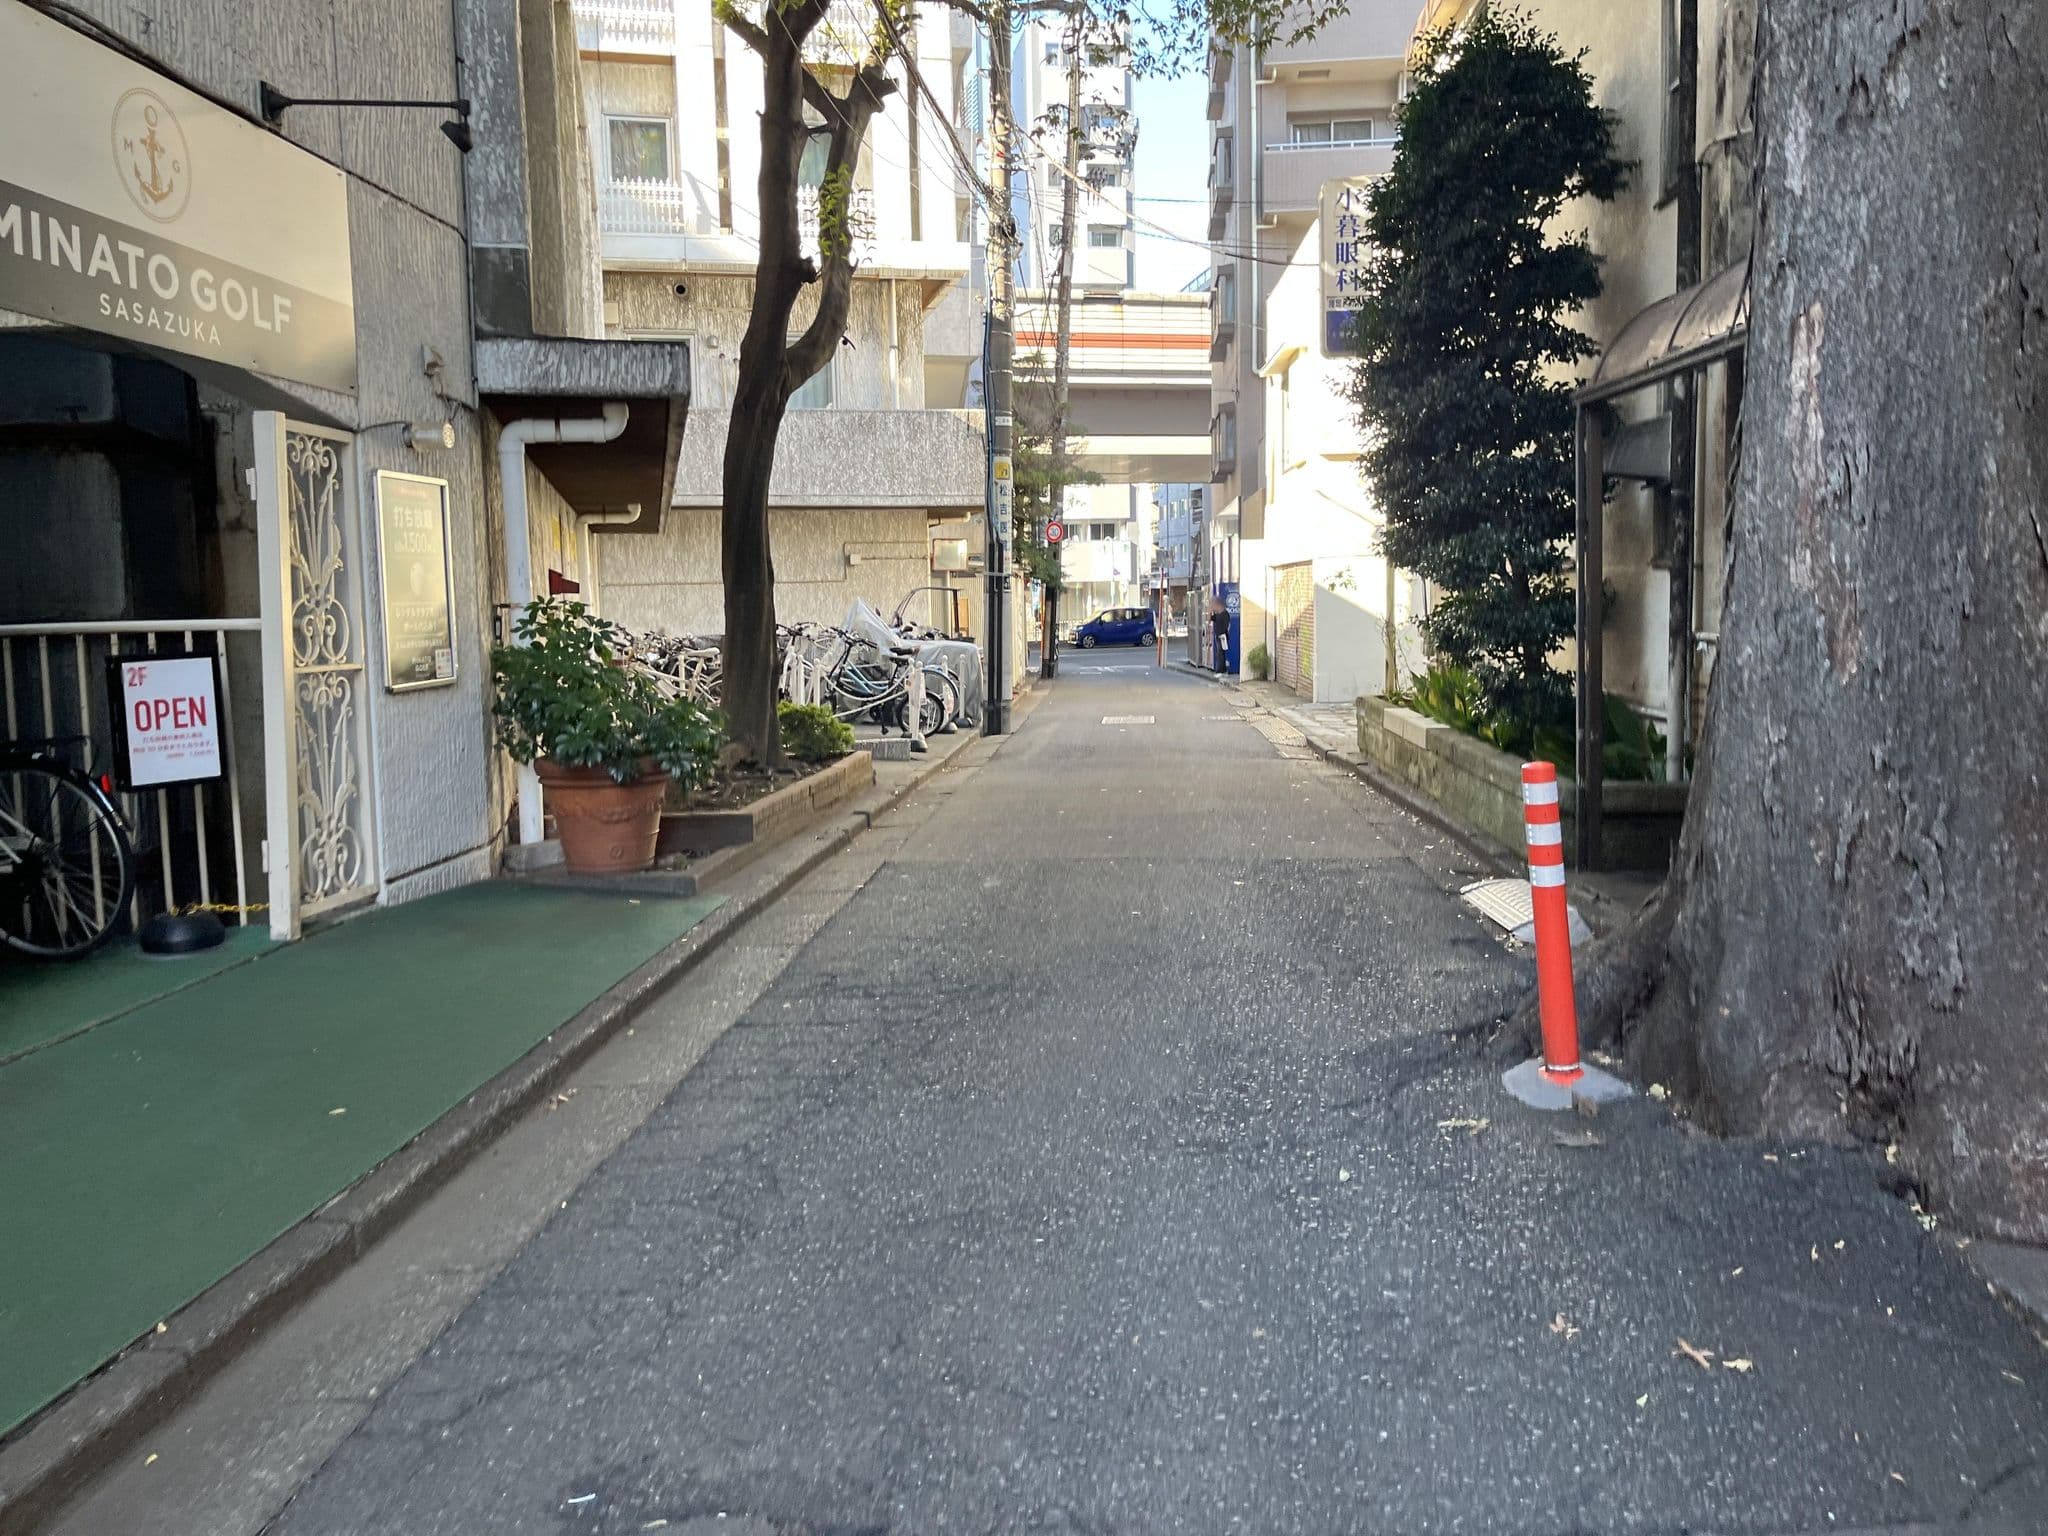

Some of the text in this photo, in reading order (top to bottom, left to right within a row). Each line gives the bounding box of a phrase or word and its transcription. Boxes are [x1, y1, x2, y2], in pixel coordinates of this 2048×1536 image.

[1335, 187, 1360, 293] 小暮眼科
[0, 204, 292, 334] MINATO GOLF
[100, 293, 222, 347] SASAZUKA
[128, 666, 147, 687] 2F
[134, 696, 207, 732] OPEN
